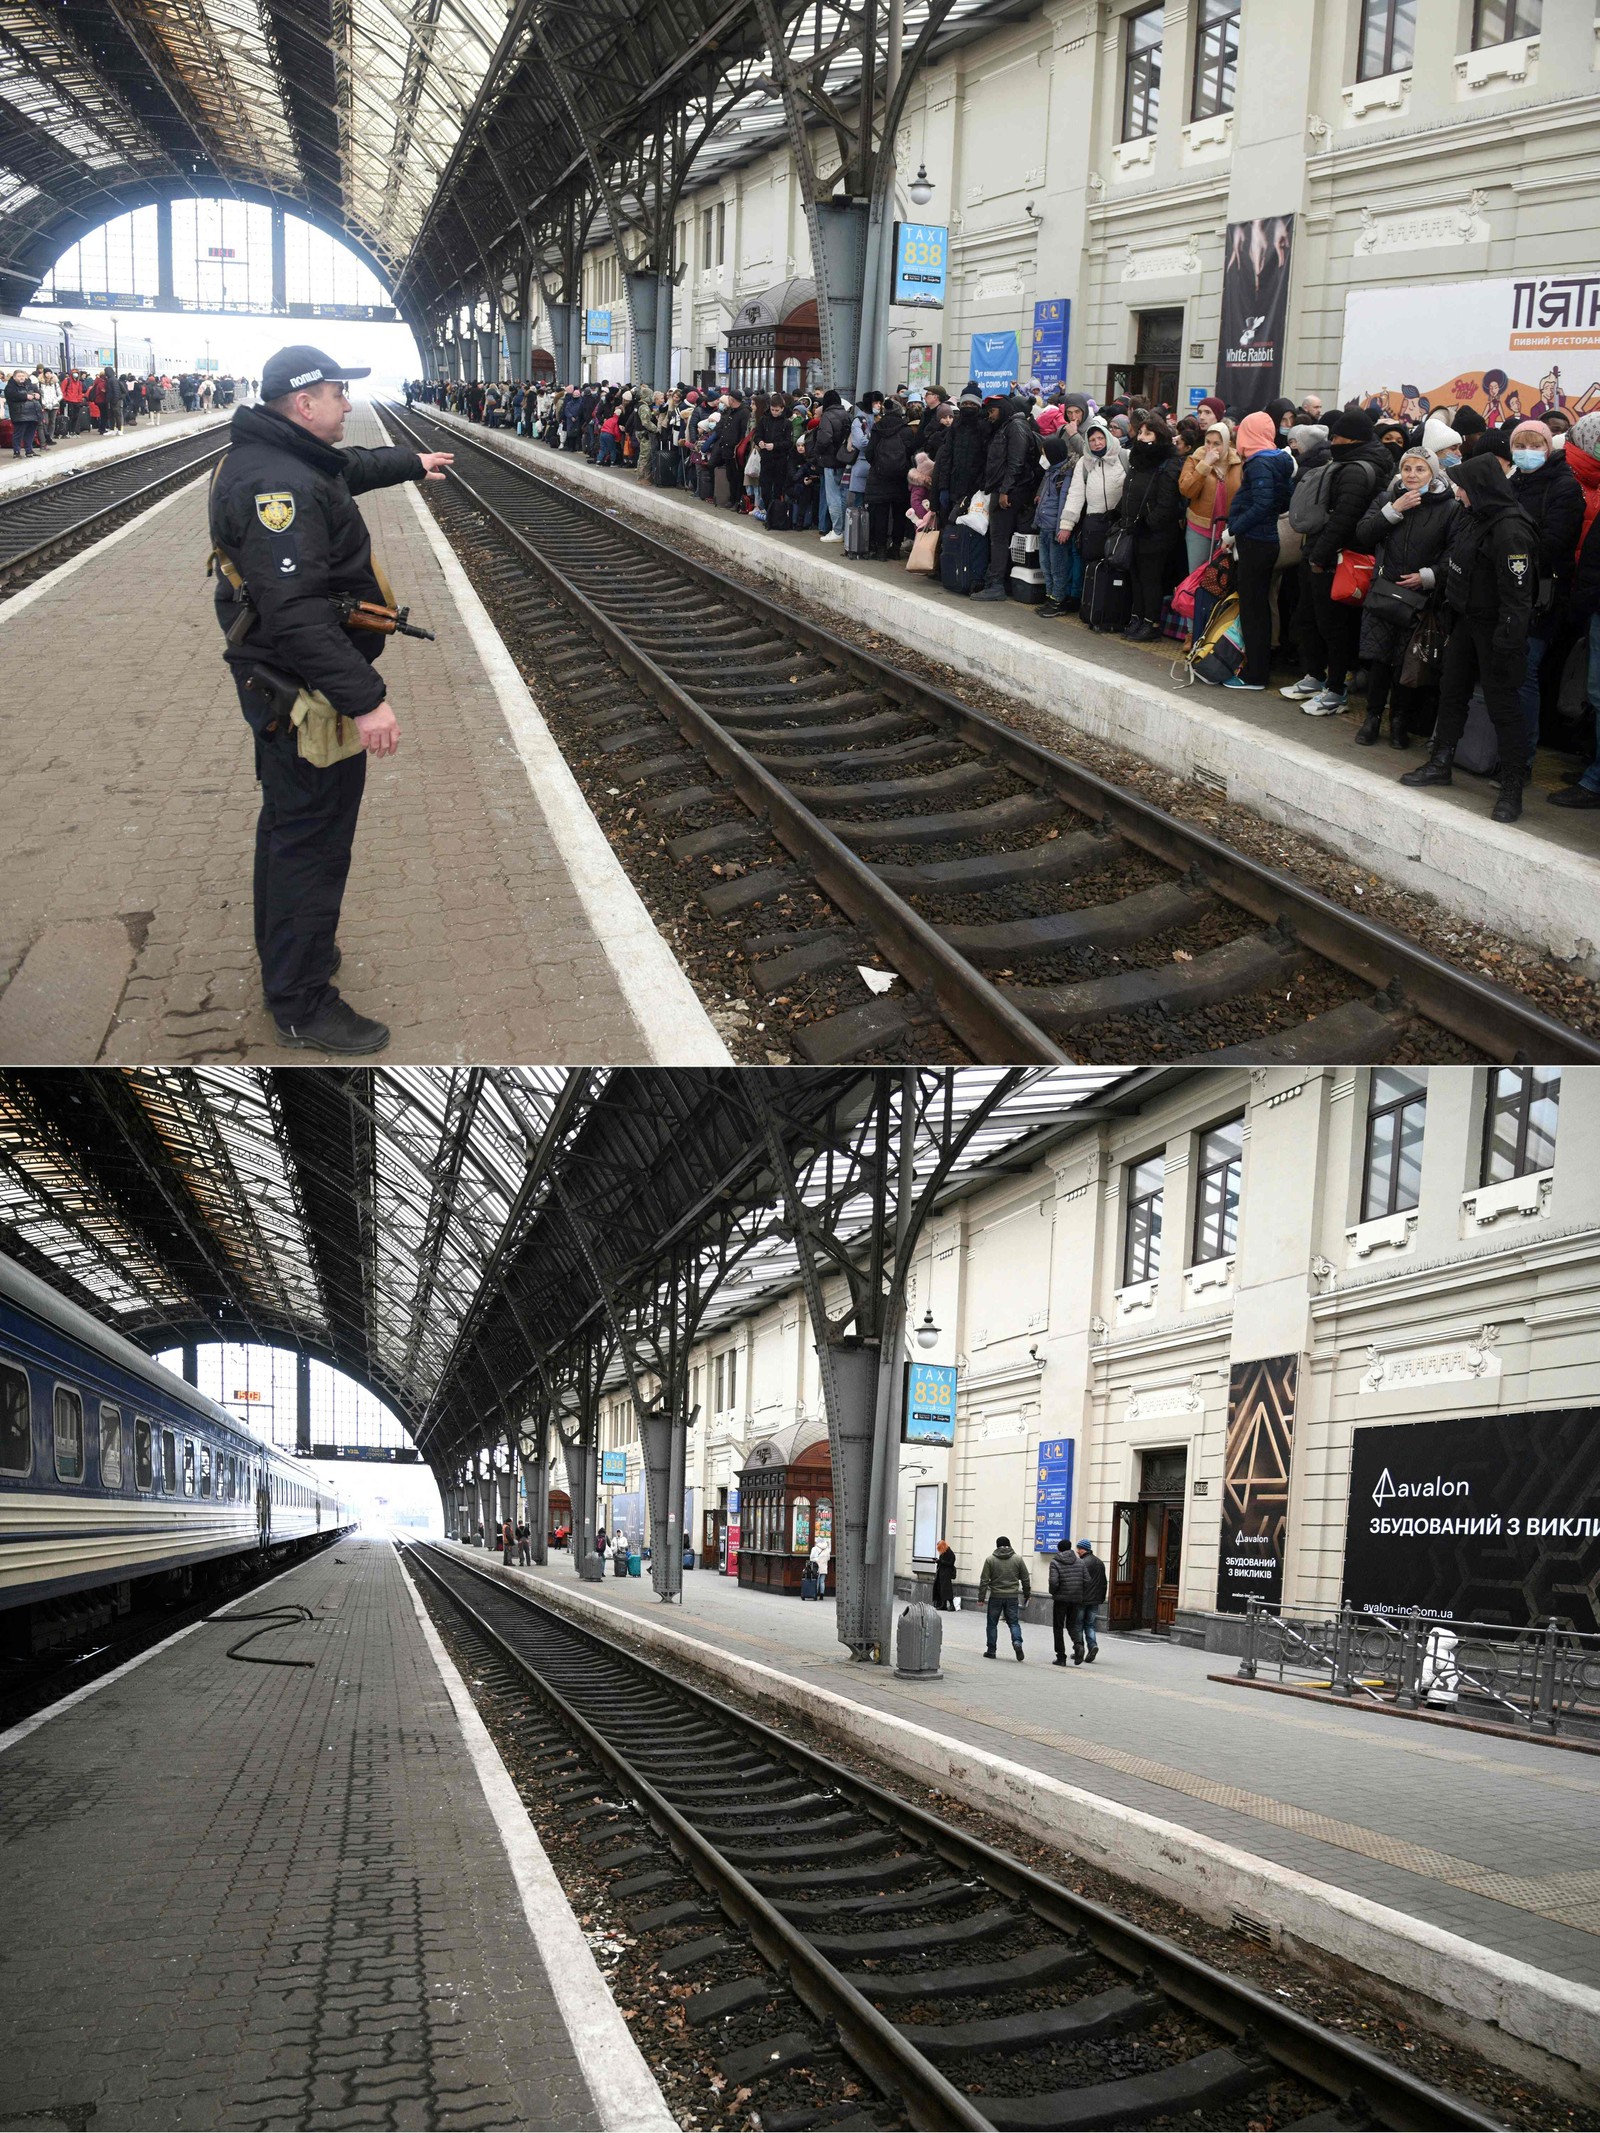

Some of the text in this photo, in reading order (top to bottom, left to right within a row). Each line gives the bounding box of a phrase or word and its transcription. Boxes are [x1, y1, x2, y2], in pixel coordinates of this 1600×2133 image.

[906, 228, 943, 243] TAXI
[904, 241, 942, 266] 838
[591, 319, 608, 329] 838
[1514, 336, 1600, 346] ПИВНИЙ РЕСТОРАН
[1226, 347, 1273, 362] White Rabbit
[290, 369, 323, 388] ПОЛІЦІЯ
[975, 370, 1013, 378] Тут вакцинують
[916, 1367, 952, 1383] TAXI
[914, 1381, 951, 1406] 838
[605, 1459, 624, 1470] 838
[1397, 1475, 1469, 1497] avalon
[1369, 1514, 1501, 1536] ЗБУДОВАНИЙ
[1506, 1517, 1520, 1535] З
[1244, 1534, 1268, 1543] avalon
[1225, 1557, 1276, 1567] ЗБУДОВАНИЙ
[1228, 1568, 1272, 1579] З ВИКЛИКІВ
[1363, 1602, 1453, 1619] avalon-incom.ua
